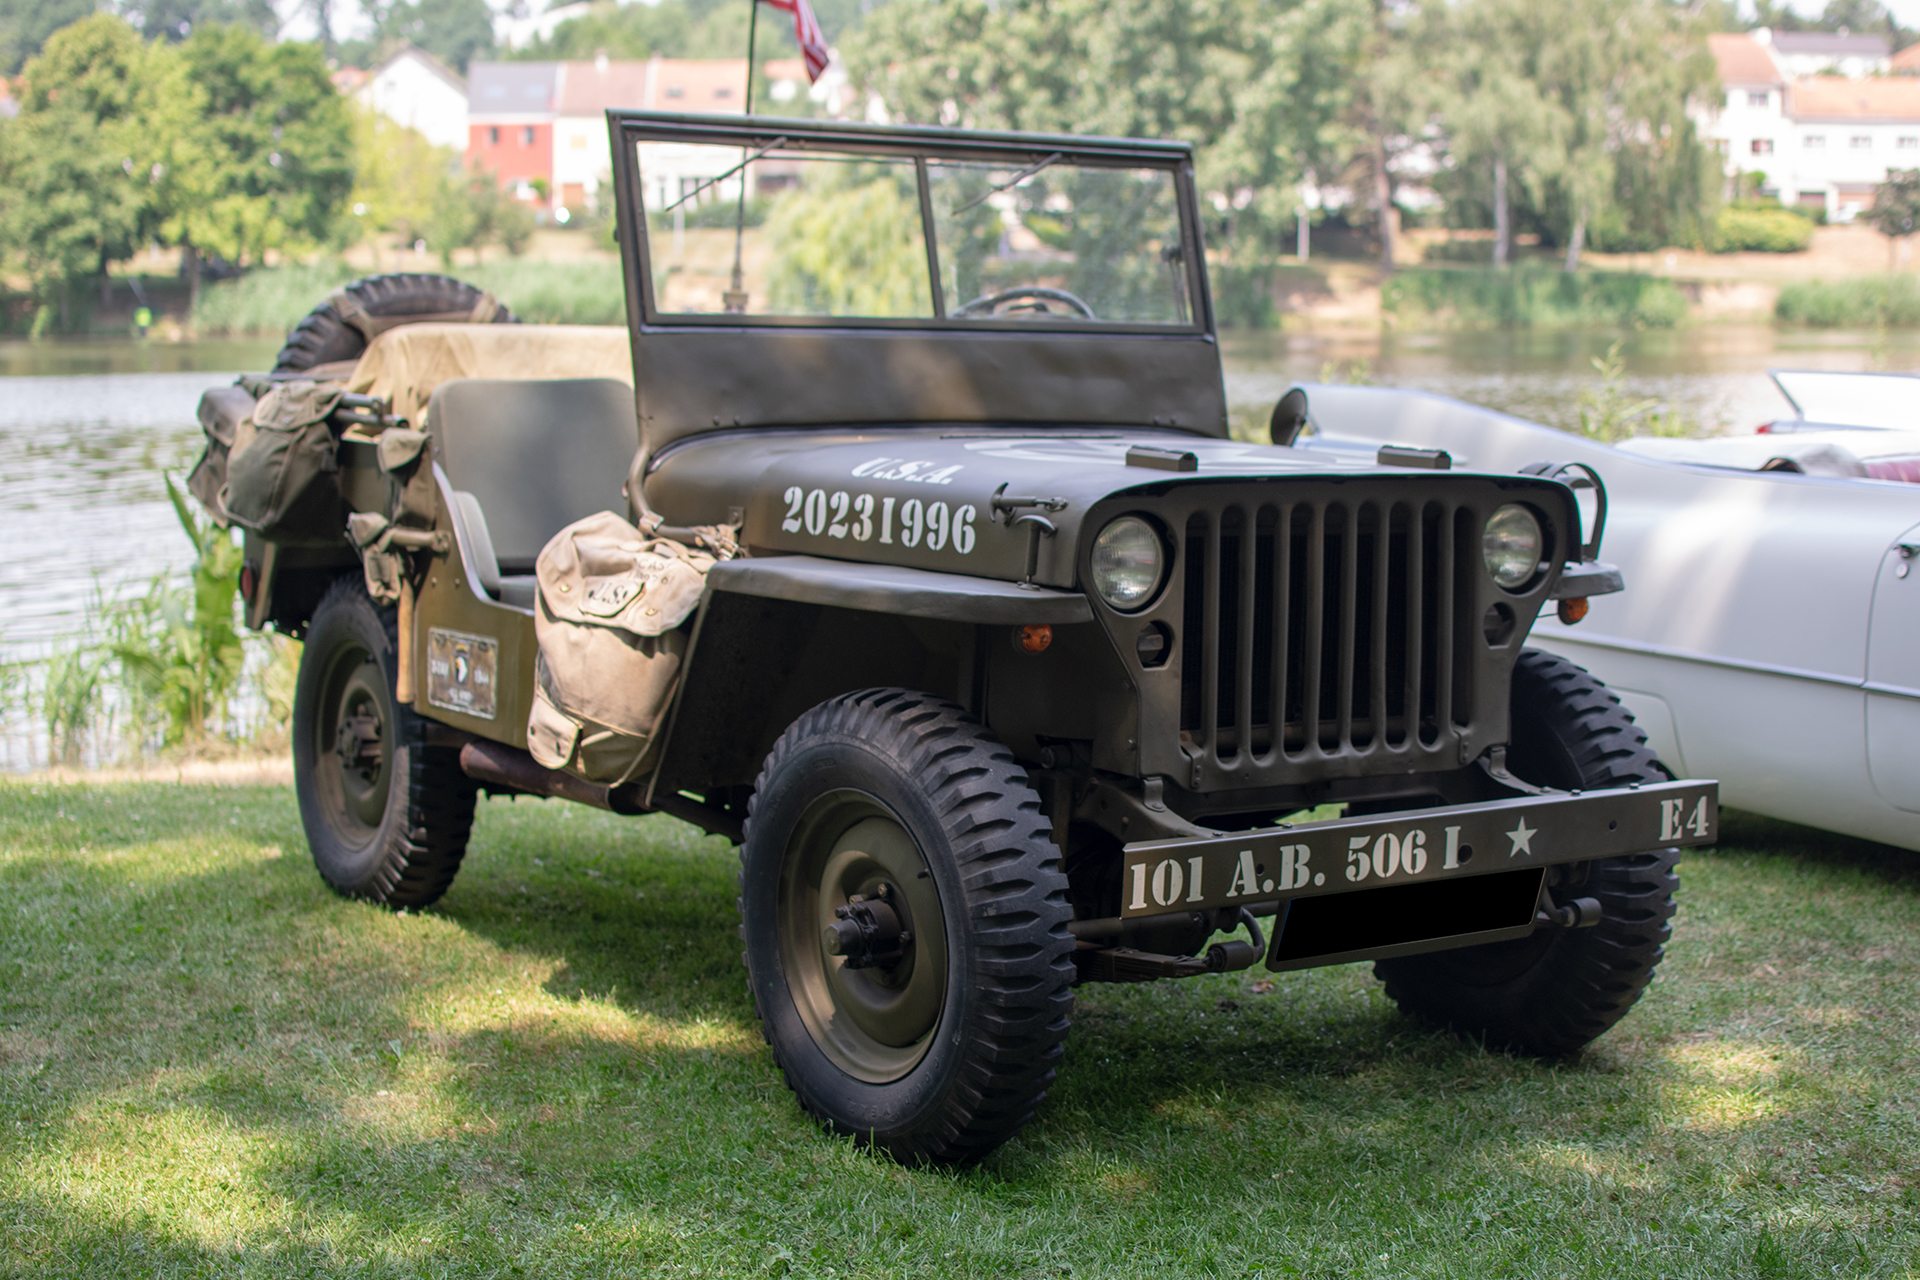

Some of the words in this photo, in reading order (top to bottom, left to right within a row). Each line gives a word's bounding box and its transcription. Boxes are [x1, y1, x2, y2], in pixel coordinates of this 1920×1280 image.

[851, 457, 965, 485] U.S.A.
[782, 486, 976, 554] 20231996
[1659, 796, 1710, 842] E4
[1129, 856, 1205, 910] 101
[1226, 844, 1326, 897] A.B.
[1345, 829, 1428, 882] 506
